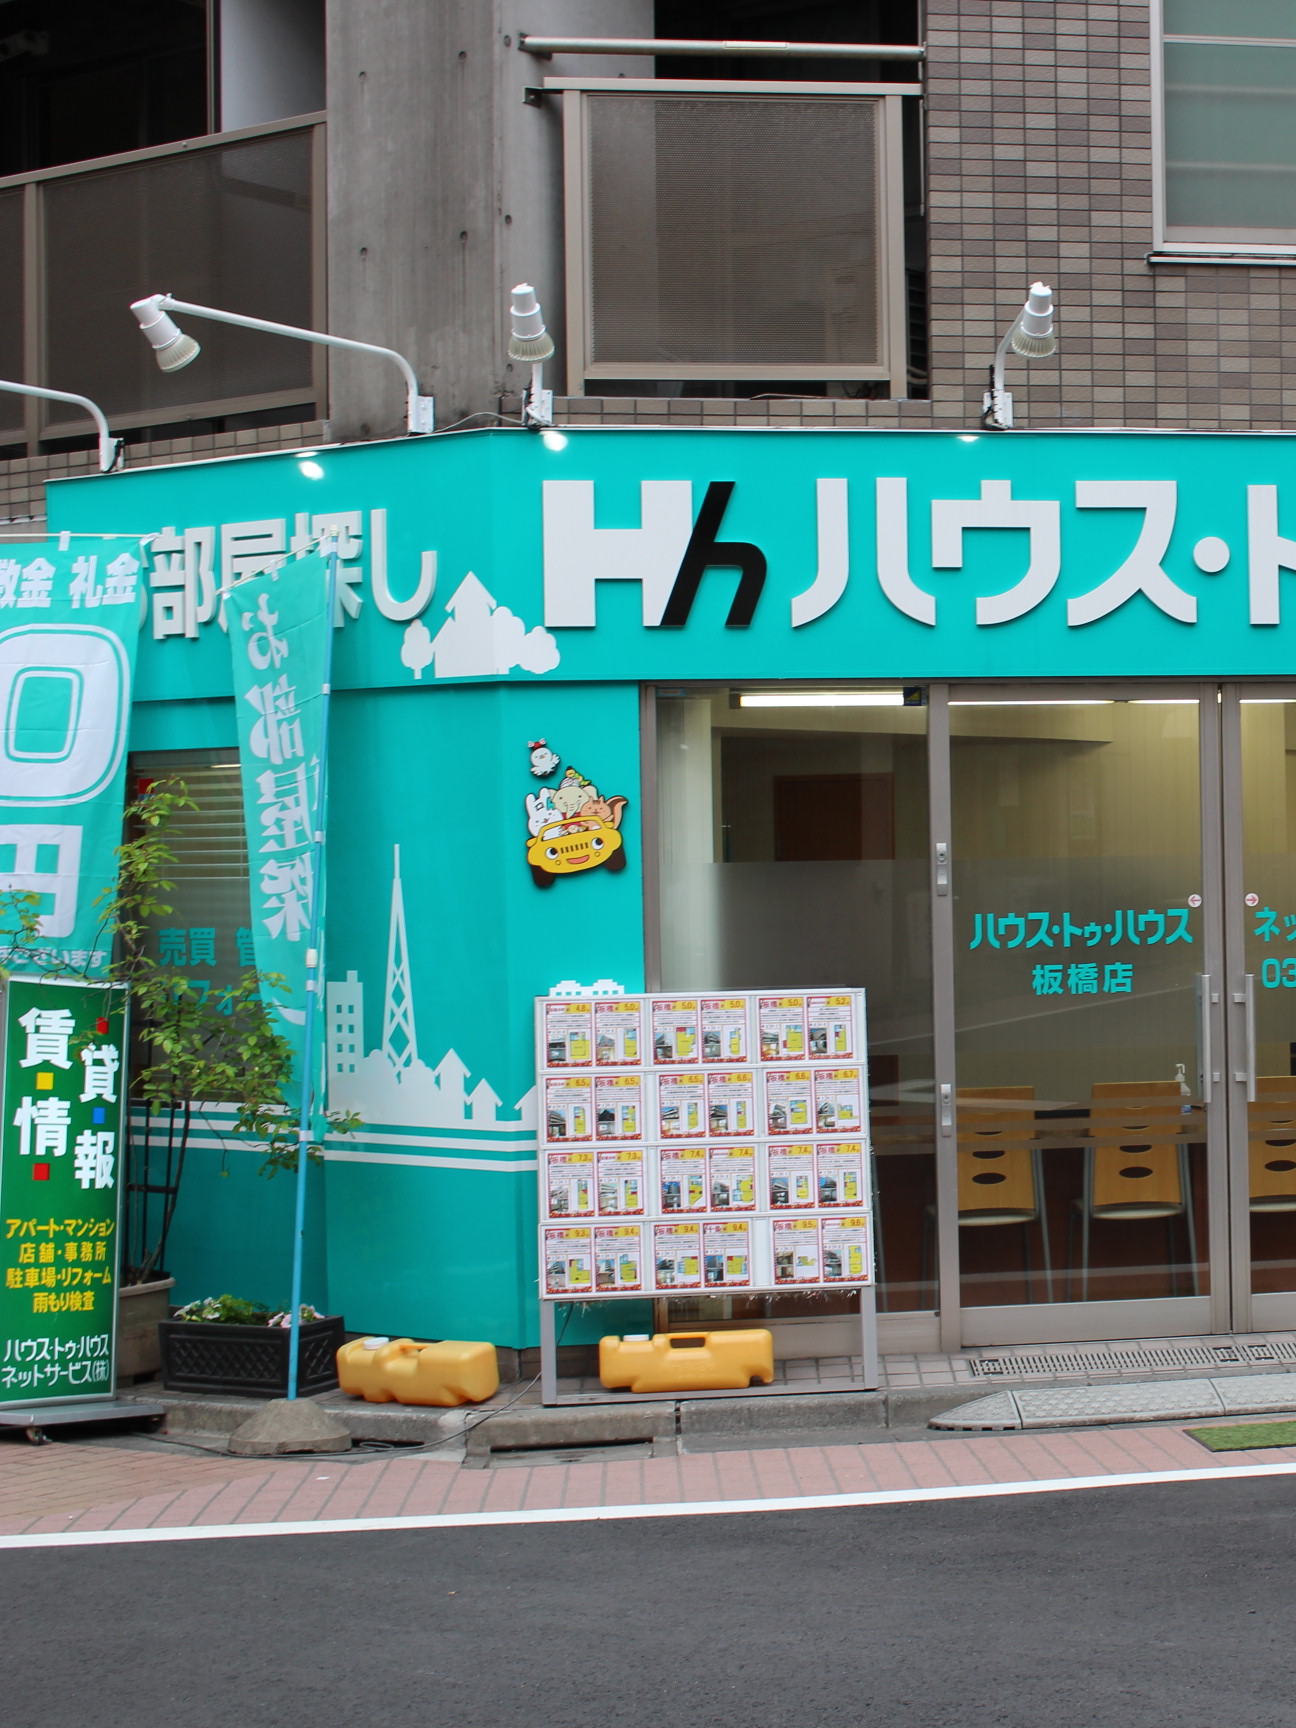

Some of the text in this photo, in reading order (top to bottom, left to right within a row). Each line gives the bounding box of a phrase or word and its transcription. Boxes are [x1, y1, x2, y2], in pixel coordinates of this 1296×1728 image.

[69, 552, 141, 609] 礼金
[138, 508, 437, 640] 部屋探し
[158, 927, 217, 967] 売買
[969, 908, 1194, 951] ハウス・トゥ・ハウス
[1031, 961, 1134, 996] 板橋店
[19, 1241, 107, 1264] 店舗・事務所
[5, 1266, 111, 1289] 駐車場・リフォーム
[32, 1290, 95, 1313] 雨もり検査
